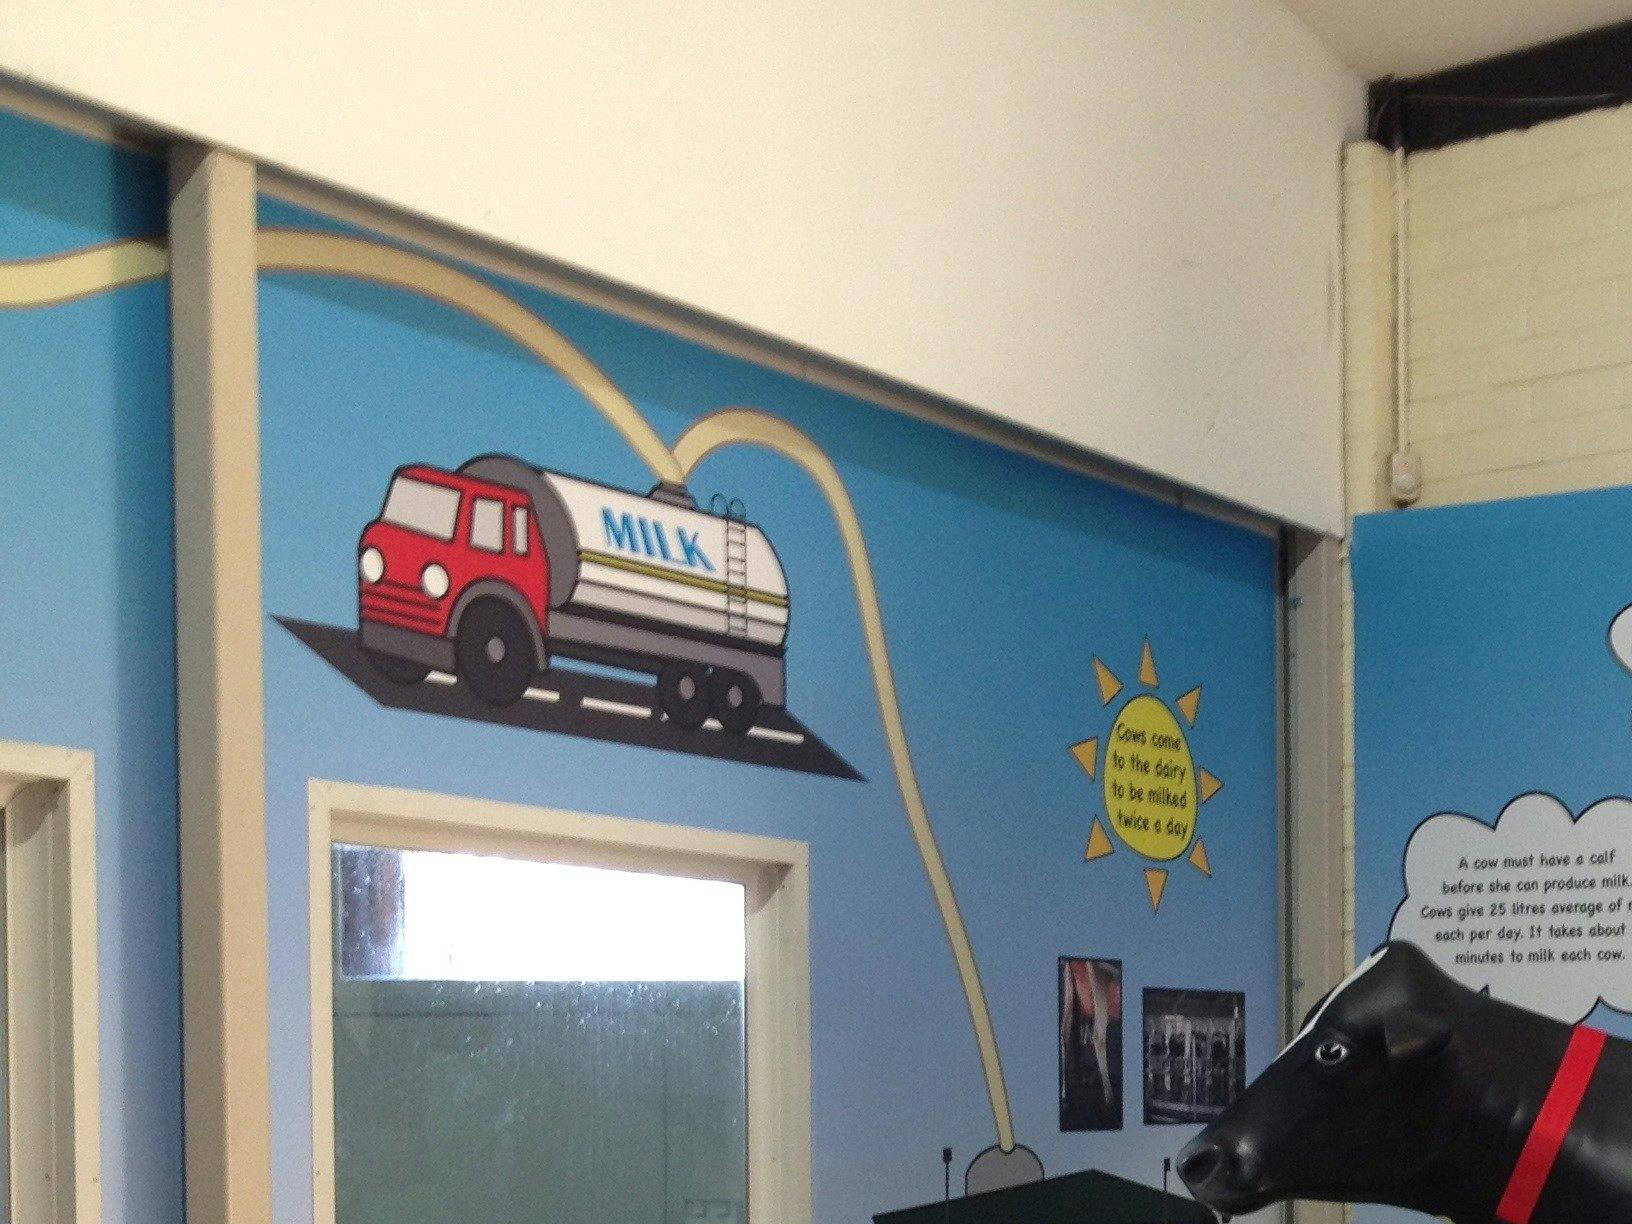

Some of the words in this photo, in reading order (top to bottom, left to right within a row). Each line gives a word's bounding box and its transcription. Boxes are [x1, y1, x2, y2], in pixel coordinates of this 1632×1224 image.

[601, 506, 717, 573] MILK
[1117, 722, 1147, 745] Cows
[1151, 732, 1182, 752] come
[1112, 749, 1124, 770] to
[1130, 753, 1149, 775] the
[1154, 758, 1186, 784] dairy
[1112, 779, 1124, 799] to
[1129, 782, 1143, 802] be
[1147, 787, 1186, 809] milked
[1117, 808, 1148, 831] twice
[1153, 818, 1161, 834] a
[1165, 816, 1188, 842] day
[1458, 856, 1468, 870] A
[1473, 858, 1498, 870] cow
[1502, 853, 1534, 868] must
[1539, 852, 1569, 867] have
[1575, 854, 1583, 865] a
[1589, 848, 1614, 865] calf
[1441, 878, 1483, 895] before
[1488, 878, 1510, 893] she
[1516, 880, 1538, 892] can
[1543, 876, 1595, 894] produce
[1601, 873, 1632, 887] milk.
[1420, 904, 1452, 919] Cows
[1457, 903, 1483, 922] give
[1512, 901, 1545, 915] litres
[1551, 902, 1602, 917] average
[1608, 897, 1621, 912] of
[1434, 927, 1464, 942] each
[1469, 929, 1491, 944] per
[1529, 924, 1541, 938] It
[1548, 923, 1582, 938] takes
[1588, 922, 1625, 937] about
[1454, 949, 1503, 964] minutes
[1510, 949, 1523, 963] to
[1527, 948, 1554, 962] milk
[1560, 947, 1591, 962] each
[1596, 949, 1624, 961] cow.
